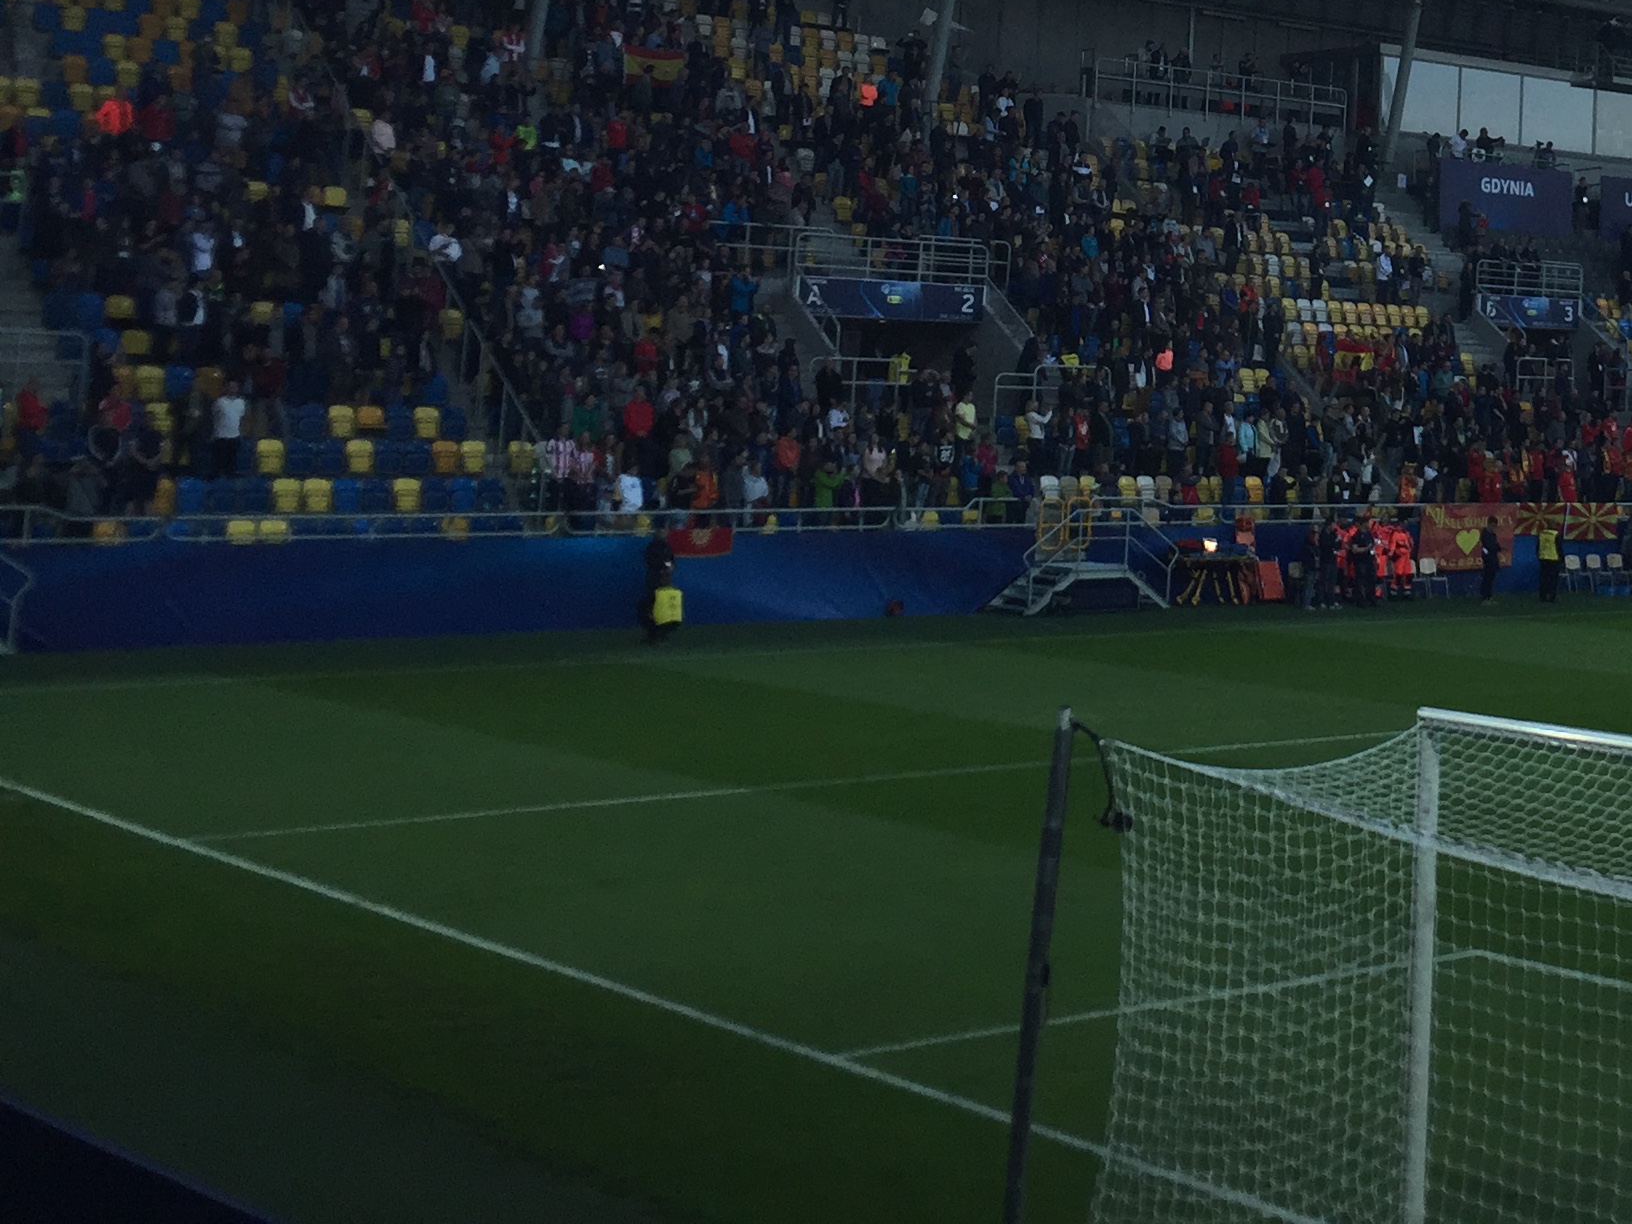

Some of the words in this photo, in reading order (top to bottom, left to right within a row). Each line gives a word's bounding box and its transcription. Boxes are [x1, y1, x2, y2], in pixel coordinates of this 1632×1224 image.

[1480, 176, 1535, 197] GDYNIA
[806, 284, 823, 306] A
[961, 293, 975, 314] 2
[1563, 306, 1574, 322] 3
